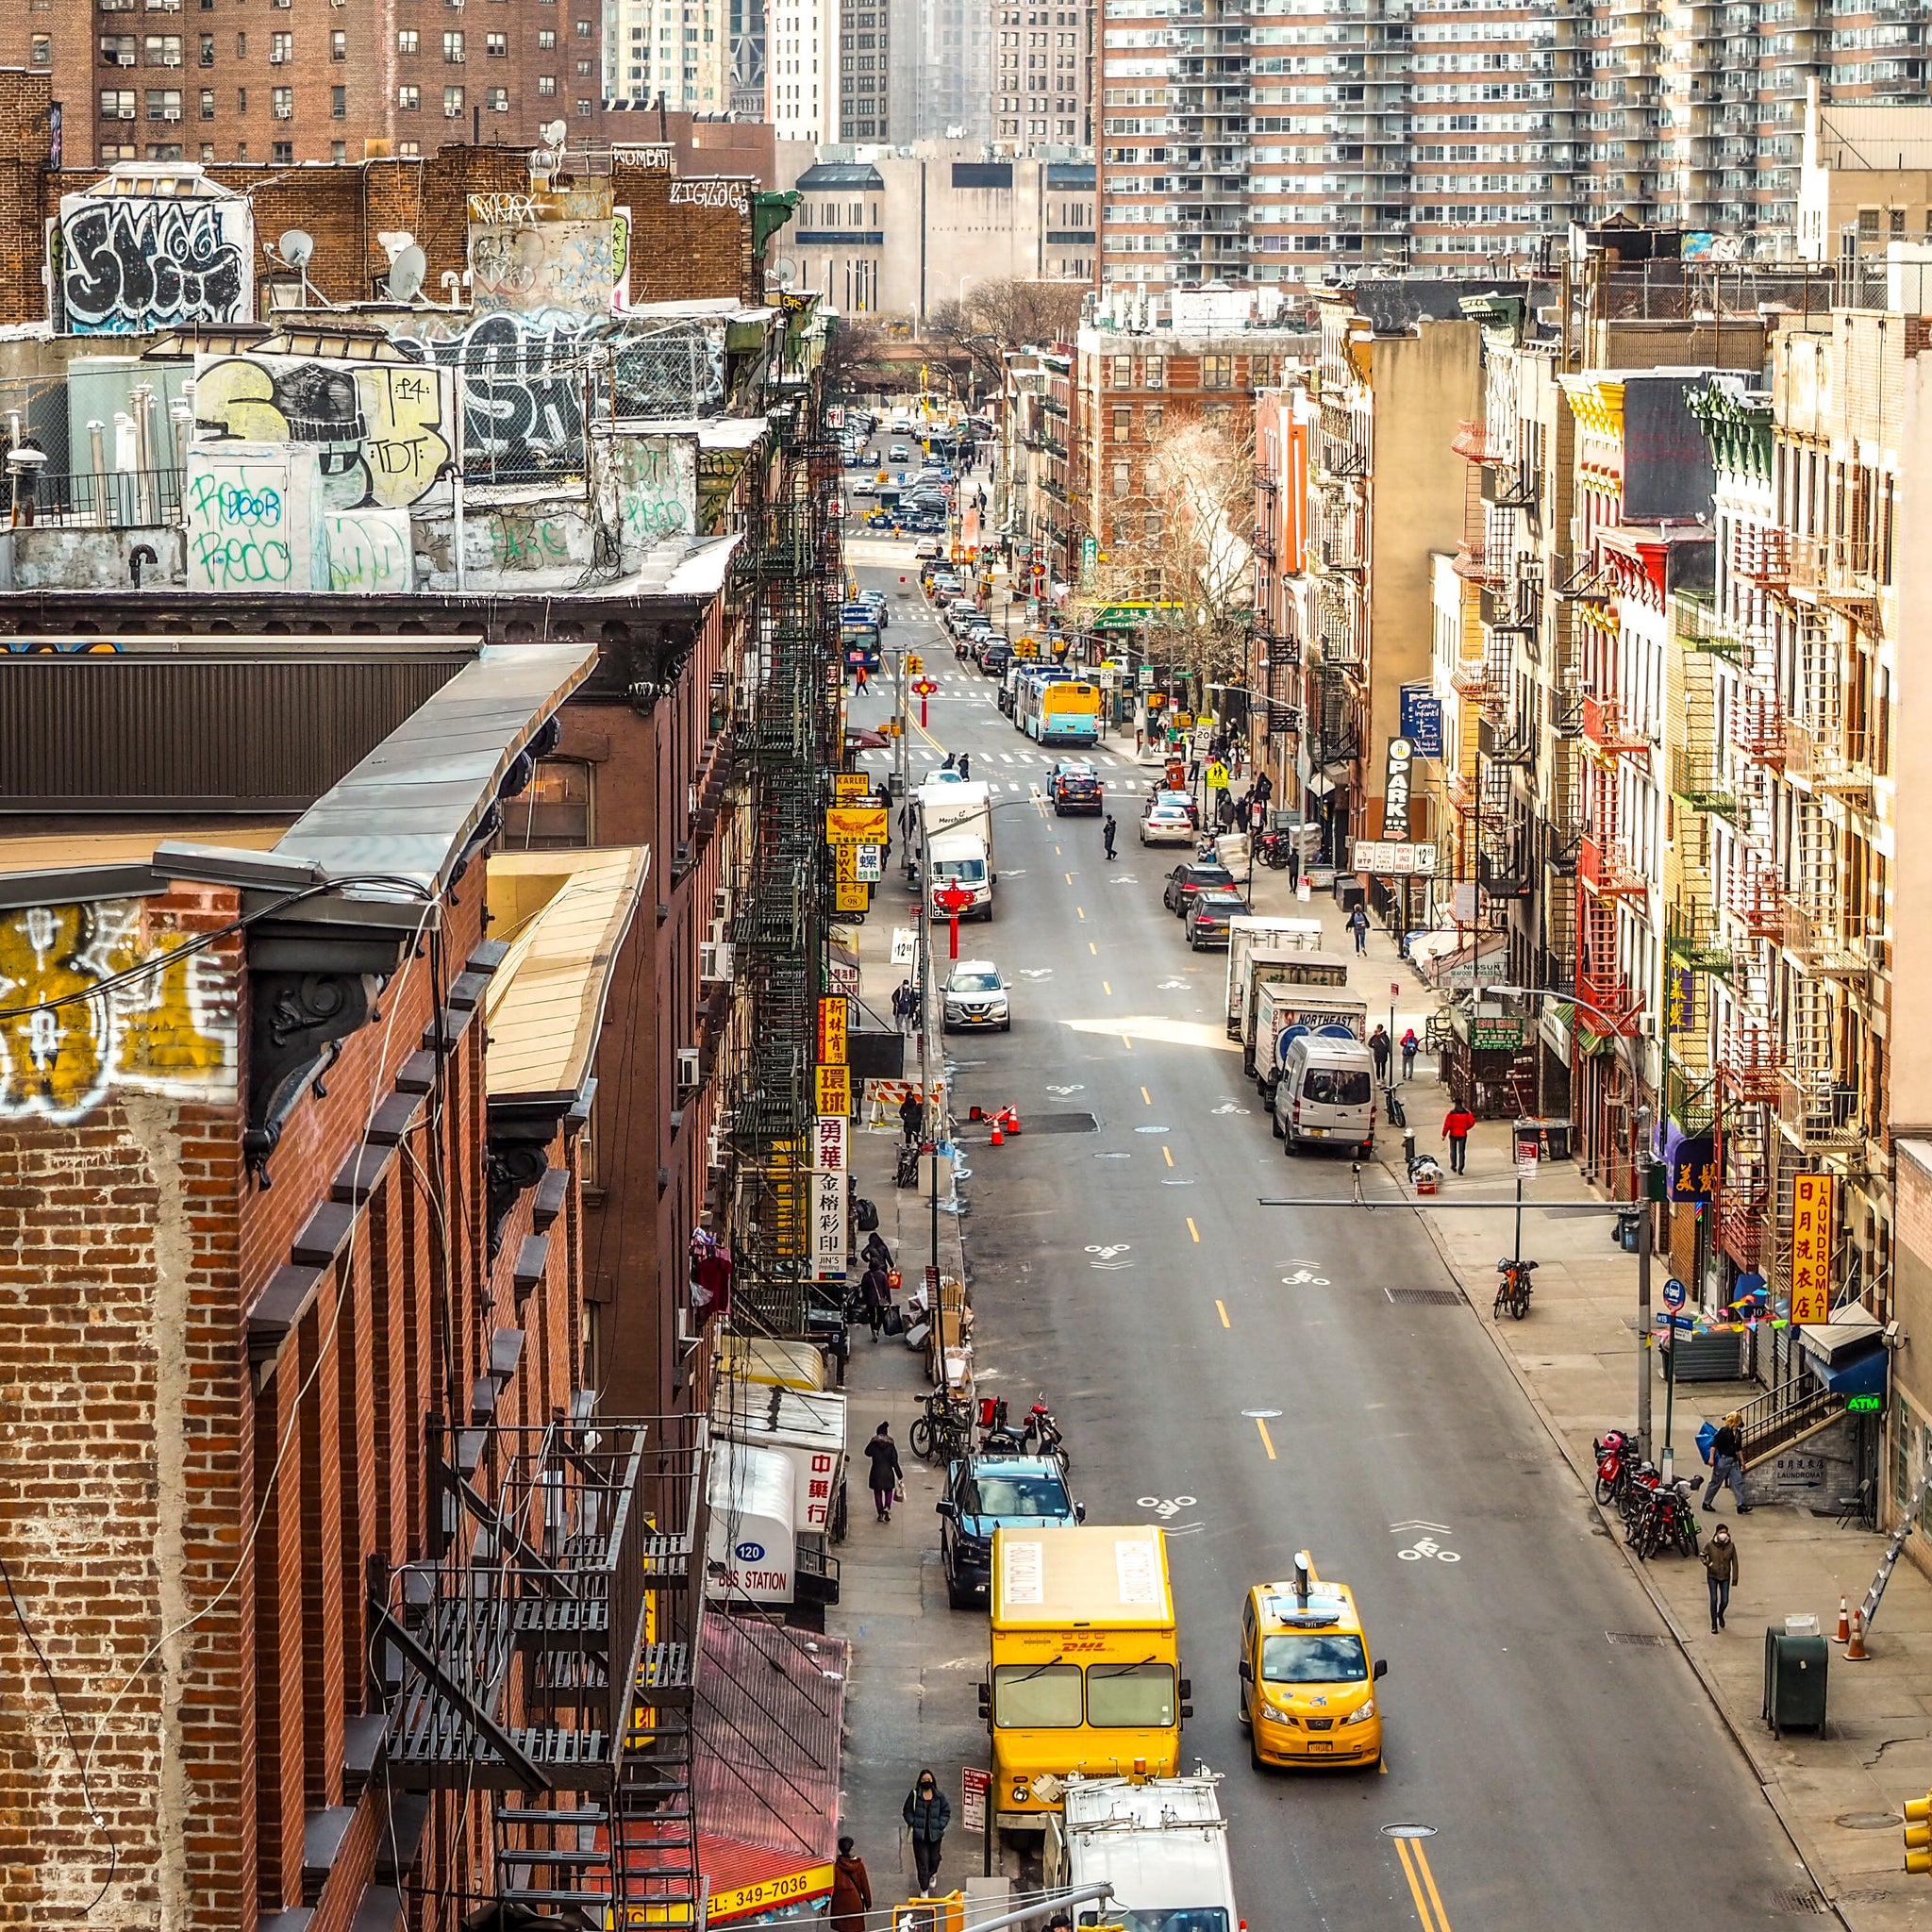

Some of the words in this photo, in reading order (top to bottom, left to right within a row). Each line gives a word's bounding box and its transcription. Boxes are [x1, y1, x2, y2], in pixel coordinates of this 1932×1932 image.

[613, 147, 670, 171] WOMBAT
[228, 491, 281, 523] DOOR
[1196, 730, 1210, 740] 20
[837, 776, 867, 785] KARLEE
[1386, 759, 1409, 817] PARK
[847, 897, 858, 906] 98
[1298, 1013, 1354, 1027] NORTHEAST
[821, 1068, 845, 1113] 環球
[820, 1119, 841, 1169] 勇華
[1675, 1162, 1715, 1193] 美髮
[818, 1173, 840, 1252] 金榕彩印
[819, 1256, 840, 1265] JIN'S
[1793, 1181, 1813, 1319] 日月洗衣店
[1814, 1181, 1828, 1318] LAUNDROMAT
[1847, 1397, 1879, 1409] ATM
[807, 1454, 831, 1524] 中藥行
[739, 1545, 759, 1558] 120
[718, 1570, 740, 1588] BUS
[744, 1570, 787, 1591] STATION
[1061, 1641, 1107, 1652] DHL
[707, 1897, 727, 1915] EL:
[735, 1874, 808, 1907] 349-7036
